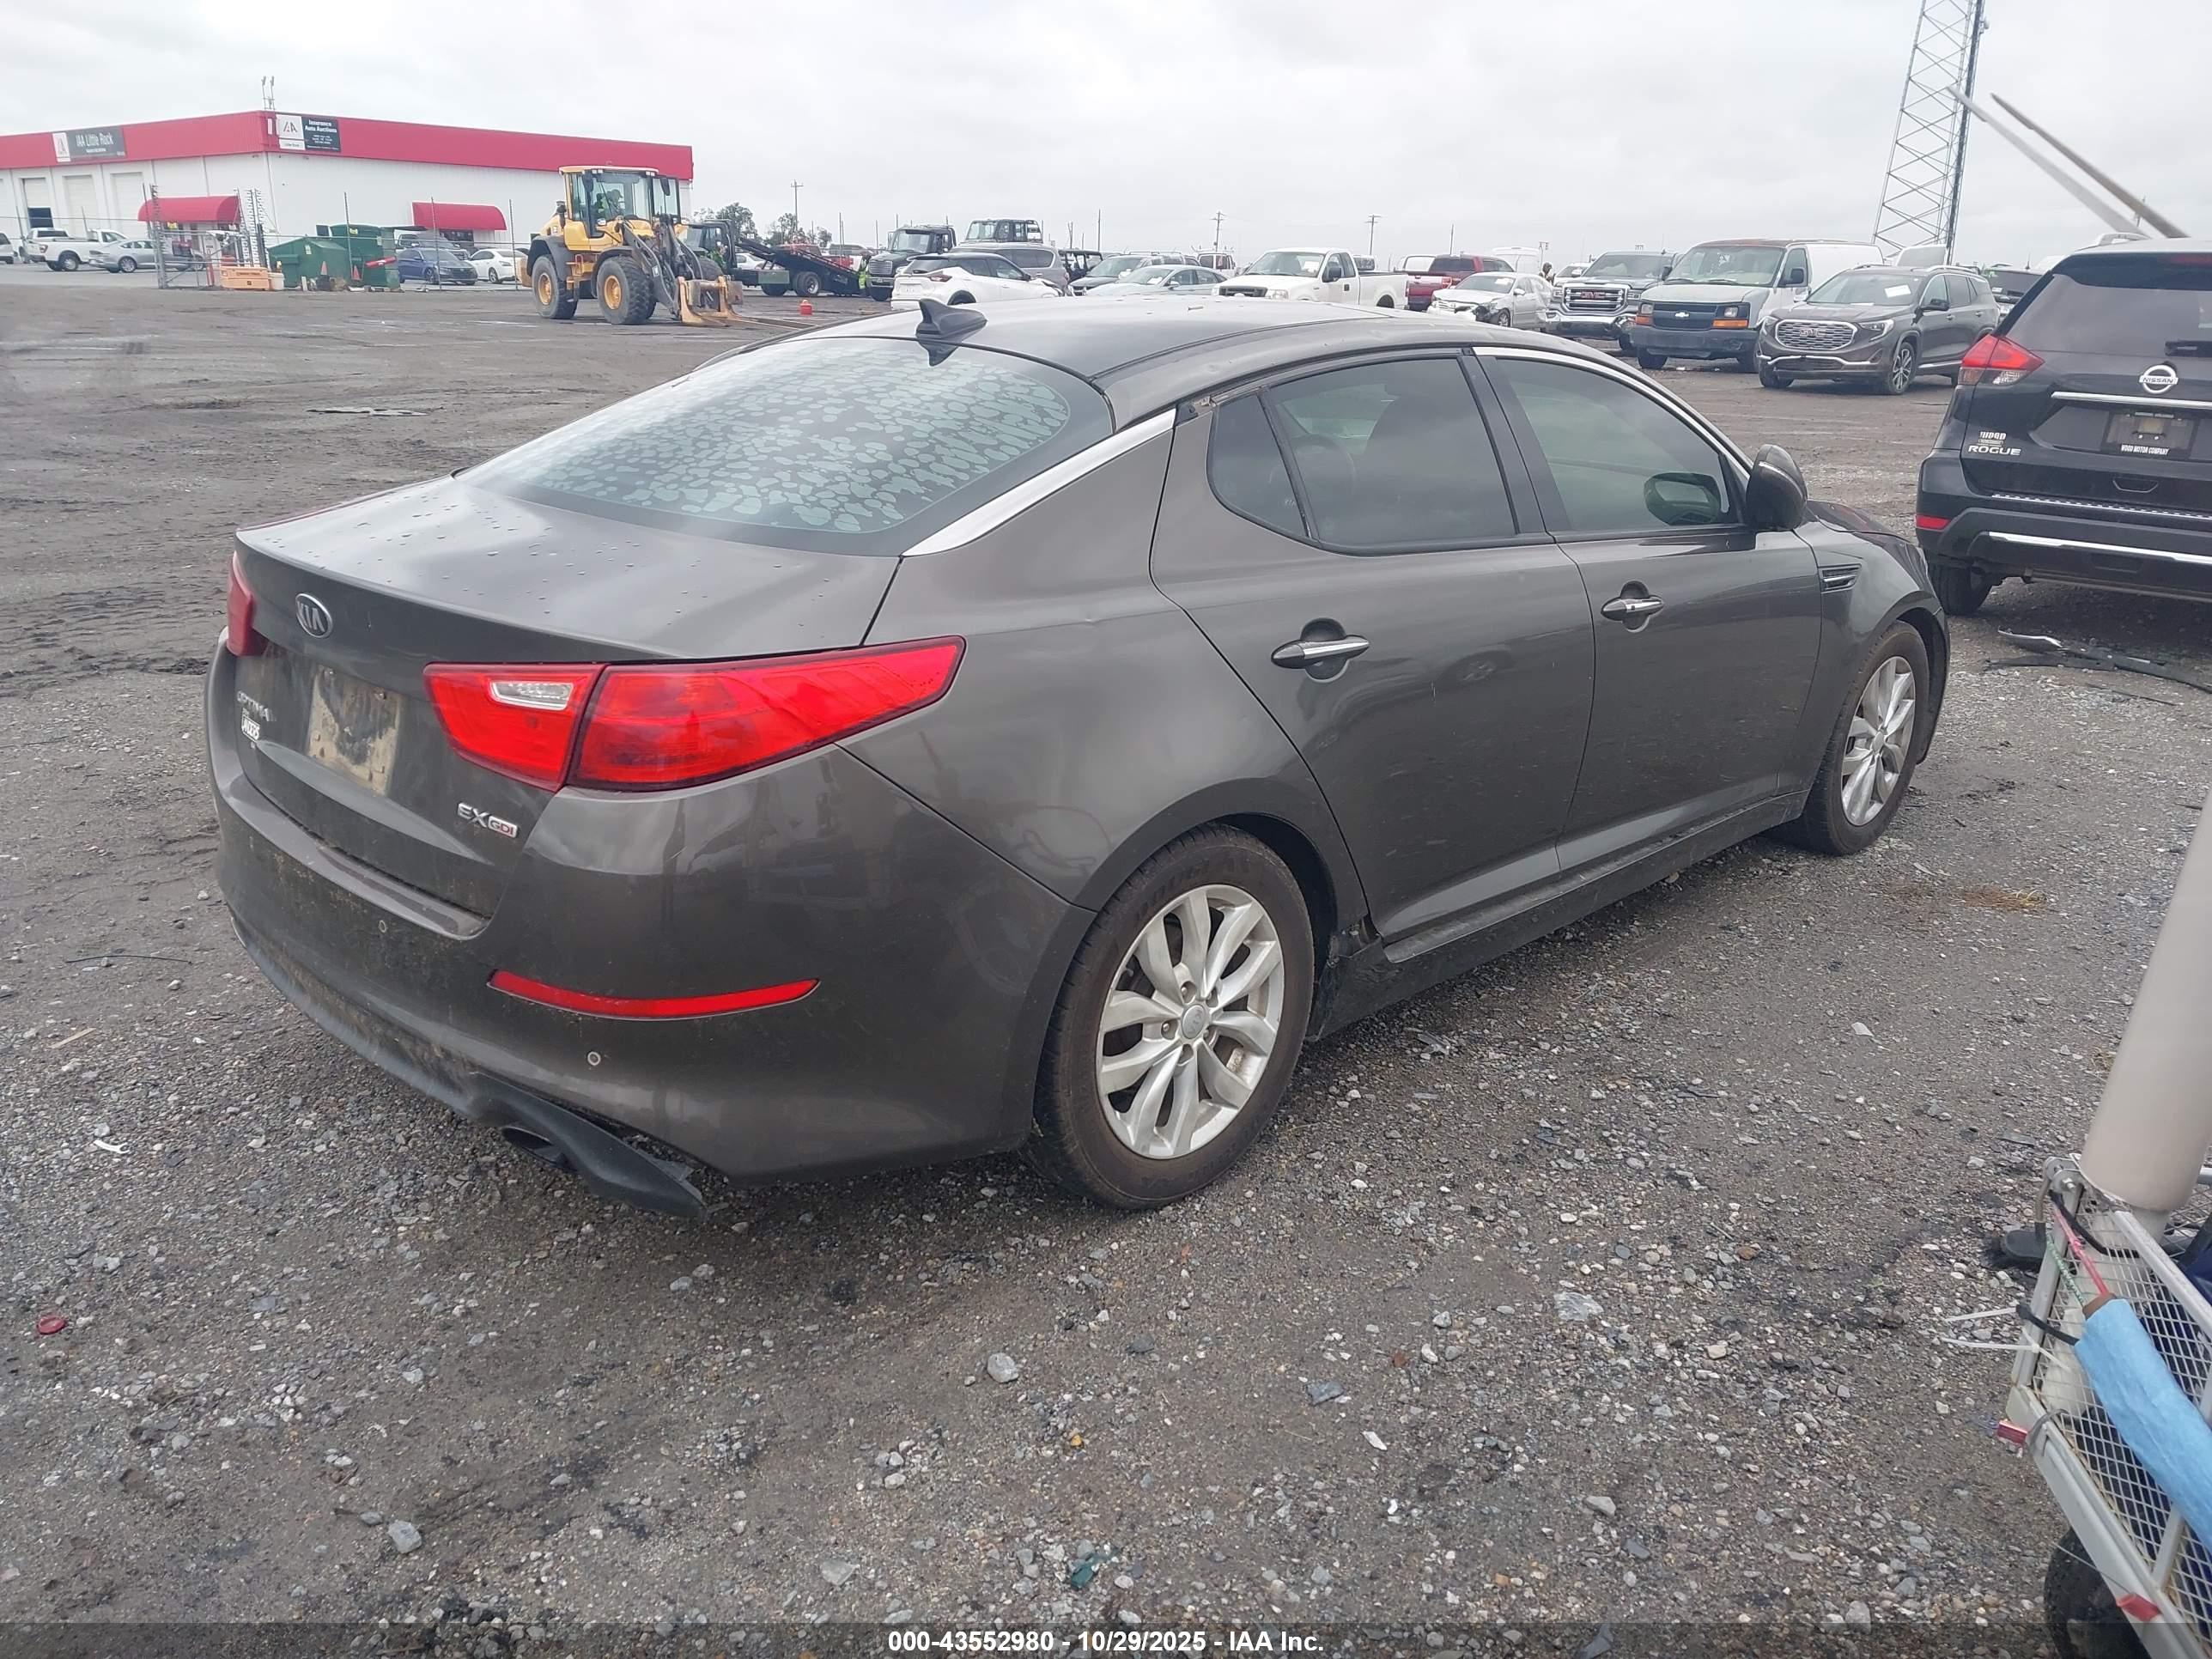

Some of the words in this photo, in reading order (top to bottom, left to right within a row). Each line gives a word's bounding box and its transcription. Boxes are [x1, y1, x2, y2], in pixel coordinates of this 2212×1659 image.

[1967, 445, 2021, 456] ROGUE
[2148, 447, 2169, 455] COMPANY
[296, 600, 325, 632] KIA
